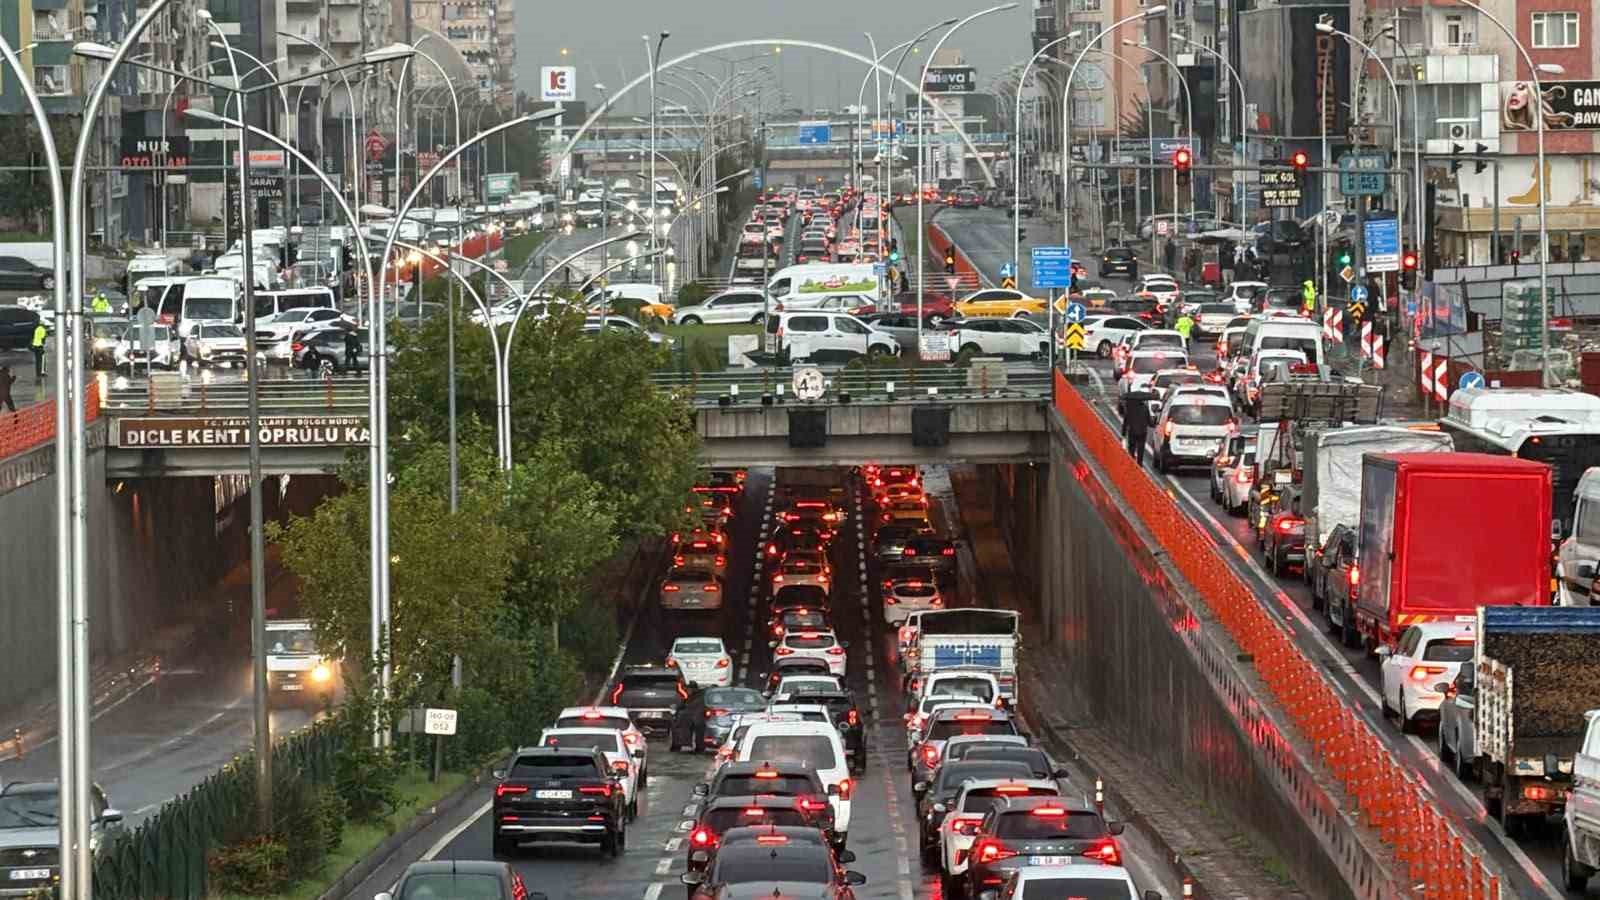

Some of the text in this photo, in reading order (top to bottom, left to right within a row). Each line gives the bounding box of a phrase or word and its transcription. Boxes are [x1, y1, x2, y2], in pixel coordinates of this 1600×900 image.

[137, 141, 170, 152] NUR
[799, 378, 809, 392] 4
[187, 428, 240, 444] KENT
